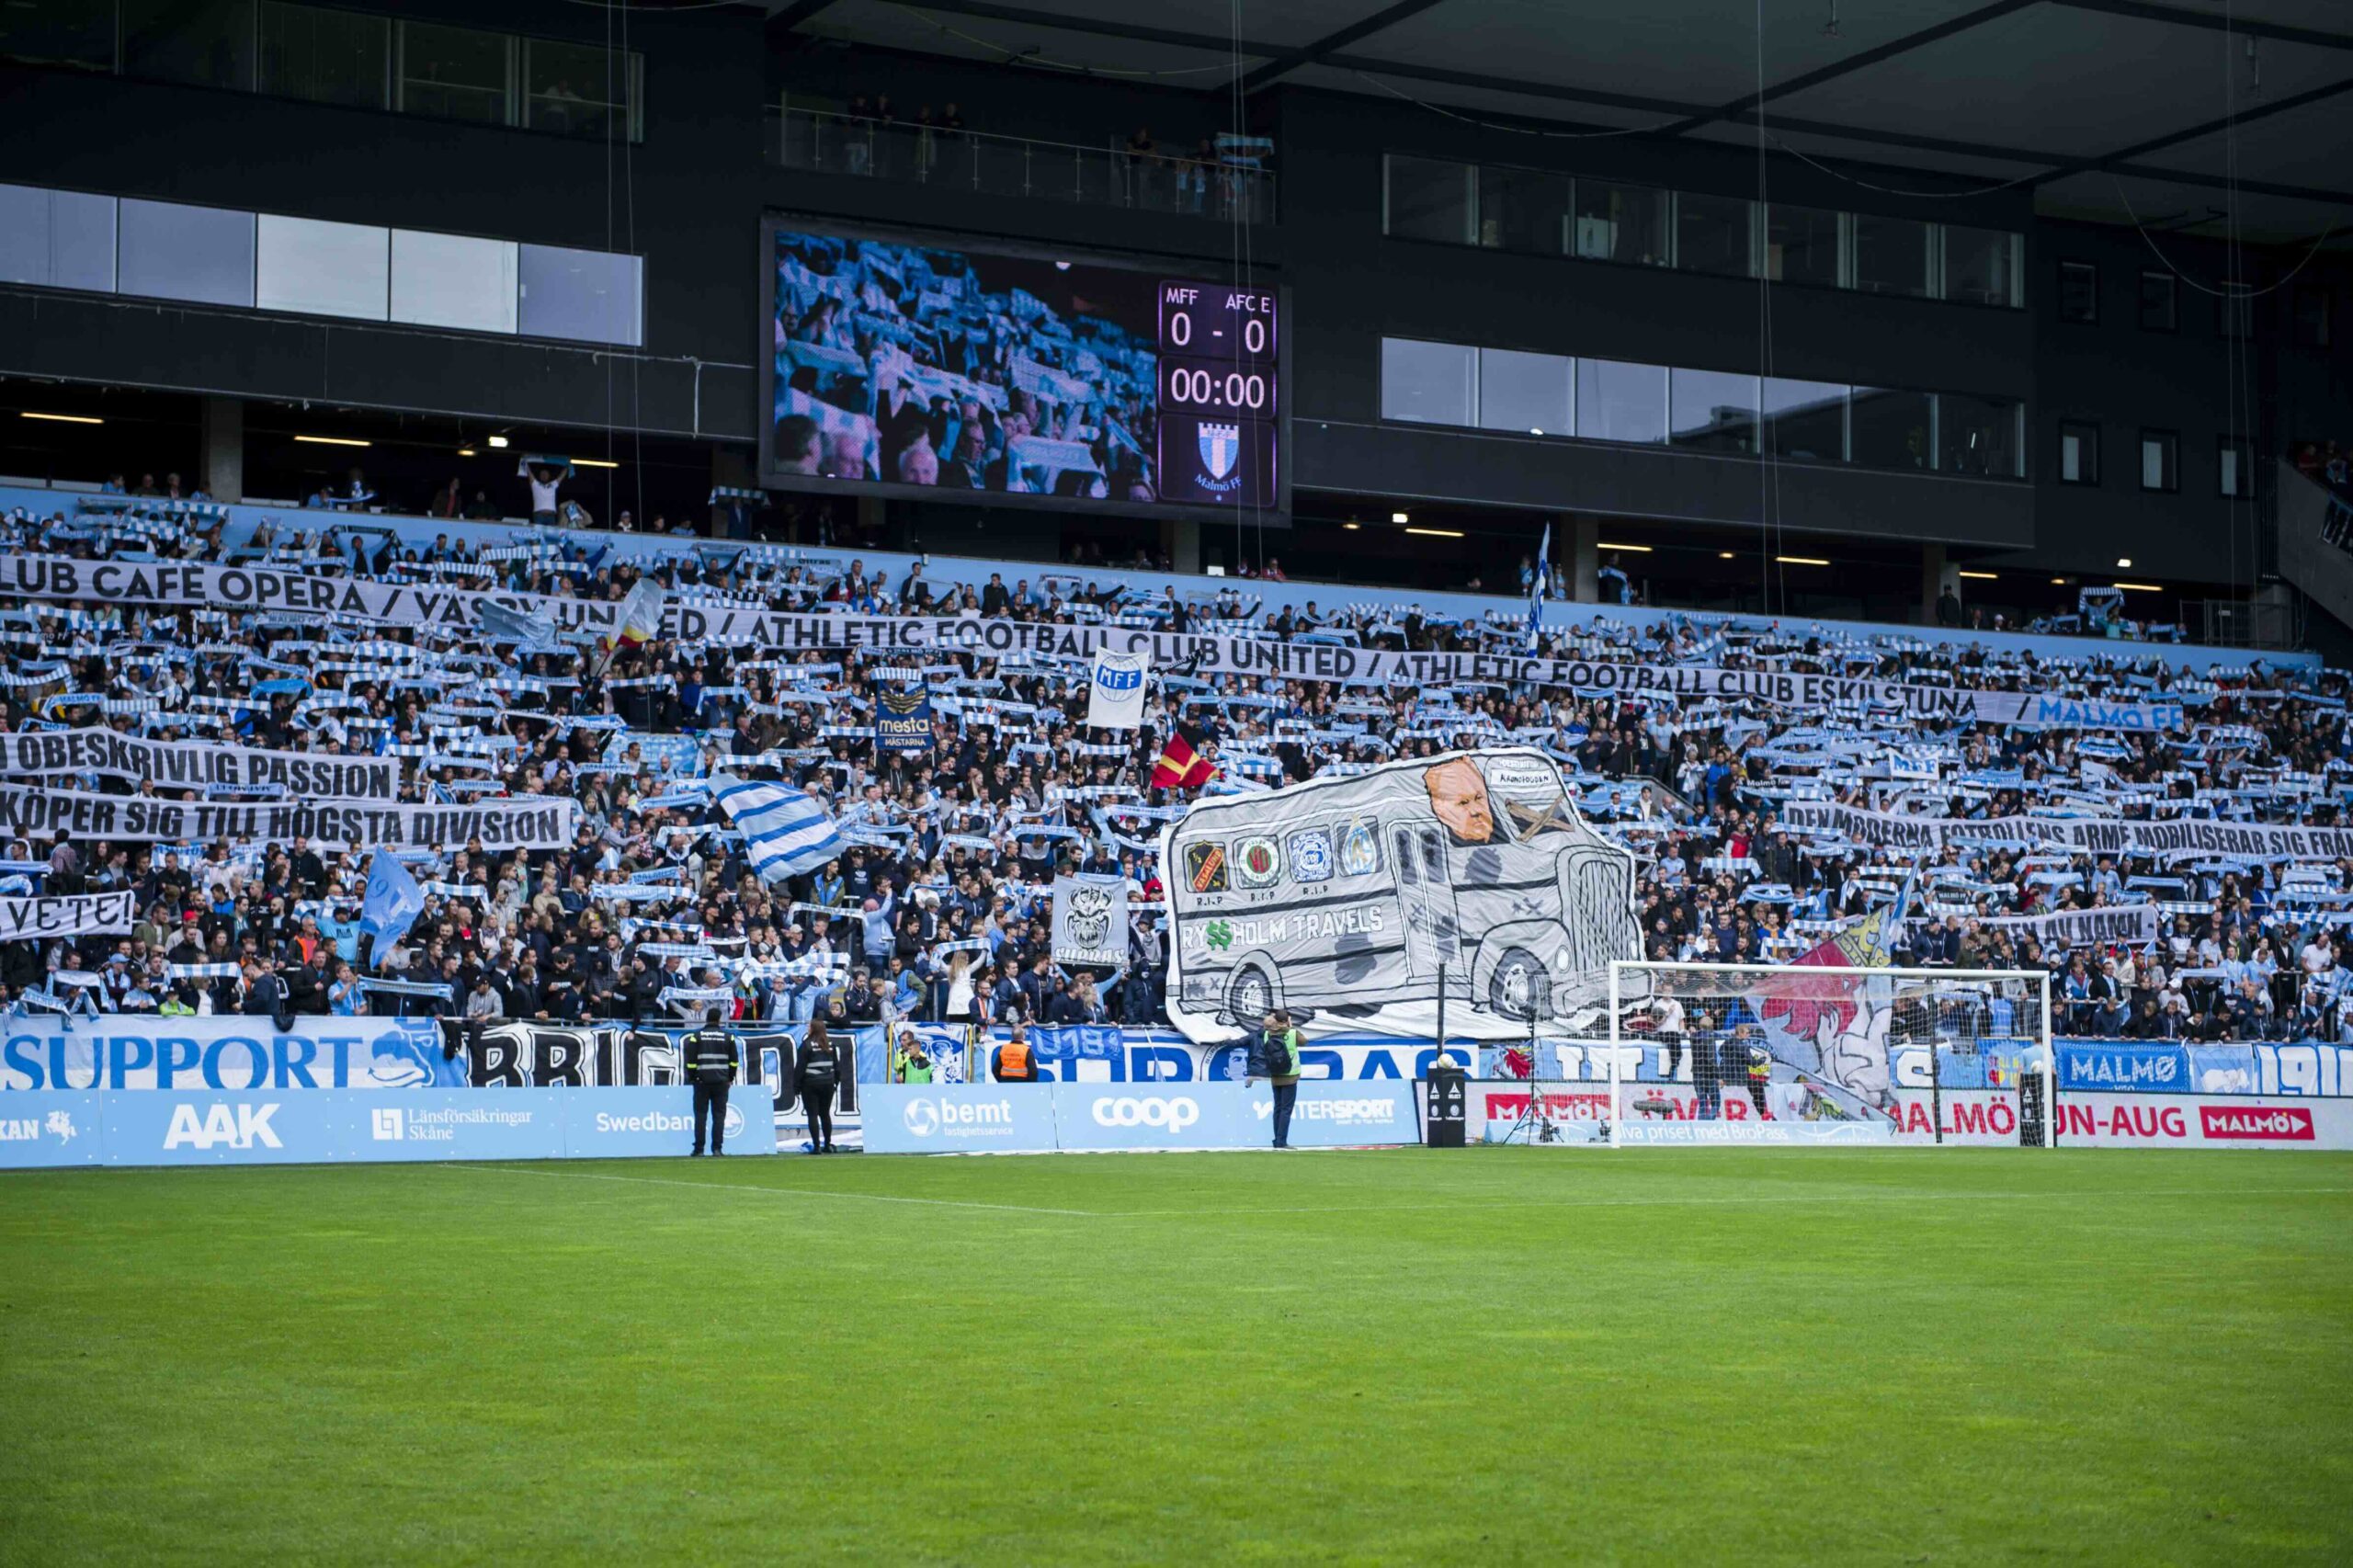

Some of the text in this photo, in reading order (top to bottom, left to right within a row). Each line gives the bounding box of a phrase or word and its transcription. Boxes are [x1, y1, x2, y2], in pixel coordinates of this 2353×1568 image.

[1166, 288, 1270, 313] MFF AFC E
[1171, 312, 1191, 347] 0
[1245, 320, 1265, 353] 0
[1171, 369, 1265, 409] 00:00
[1195, 473, 1229, 492] Malmö
[92, 566, 206, 600] CAFE
[219, 570, 369, 615] OPERA
[560, 602, 707, 641] UNED
[751, 614, 924, 648] ATHLETIC
[1127, 632, 1221, 667] CLUB
[1231, 640, 1357, 677] UNITED
[1392, 653, 1542, 684] ATHLETIC
[1552, 660, 1710, 695] FOOTBALL
[1718, 672, 1794, 703] CLUB
[2038, 696, 2143, 729] MALMÖ
[1099, 668, 1137, 687] MFF
[879, 717, 929, 733] mesta
[17, 733, 239, 784] OBESKRIVLIG
[248, 753, 390, 799] PASSION
[0, 789, 561, 846] KÖPER SIG TILL HÖGSTA DIVISION
[1832, 808, 1933, 847] MODERNA
[2074, 820, 2131, 854] ARMÉ
[2135, 824, 2267, 856] MOBILISERAR
[2269, 830, 2308, 856] SIG
[6, 892, 130, 933] VETE!
[1292, 904, 1384, 940] TRAVELS
[2077, 912, 2143, 943] NAMN
[1034, 1027, 1104, 1056] U18
[4, 1034, 363, 1090] SUPPORT
[2071, 1054, 2177, 1083] MALMØ
[407, 1108, 533, 1127] Länsförsäkringar
[596, 1112, 698, 1131] Swedban
[940, 1097, 1012, 1123] bemt
[1092, 1096, 1199, 1133] coop
[1287, 1098, 1394, 1119] TERSPORT
[2206, 1111, 2290, 1133] MALMÖ
[163, 1104, 284, 1150] AAK
[409, 1124, 454, 1141] Skåne
[943, 1126, 1013, 1138] fastighetsservice
[1647, 1124, 1693, 1143] priset
[1699, 1123, 1730, 1140] med
[1732, 1123, 1788, 1141] BroPass
